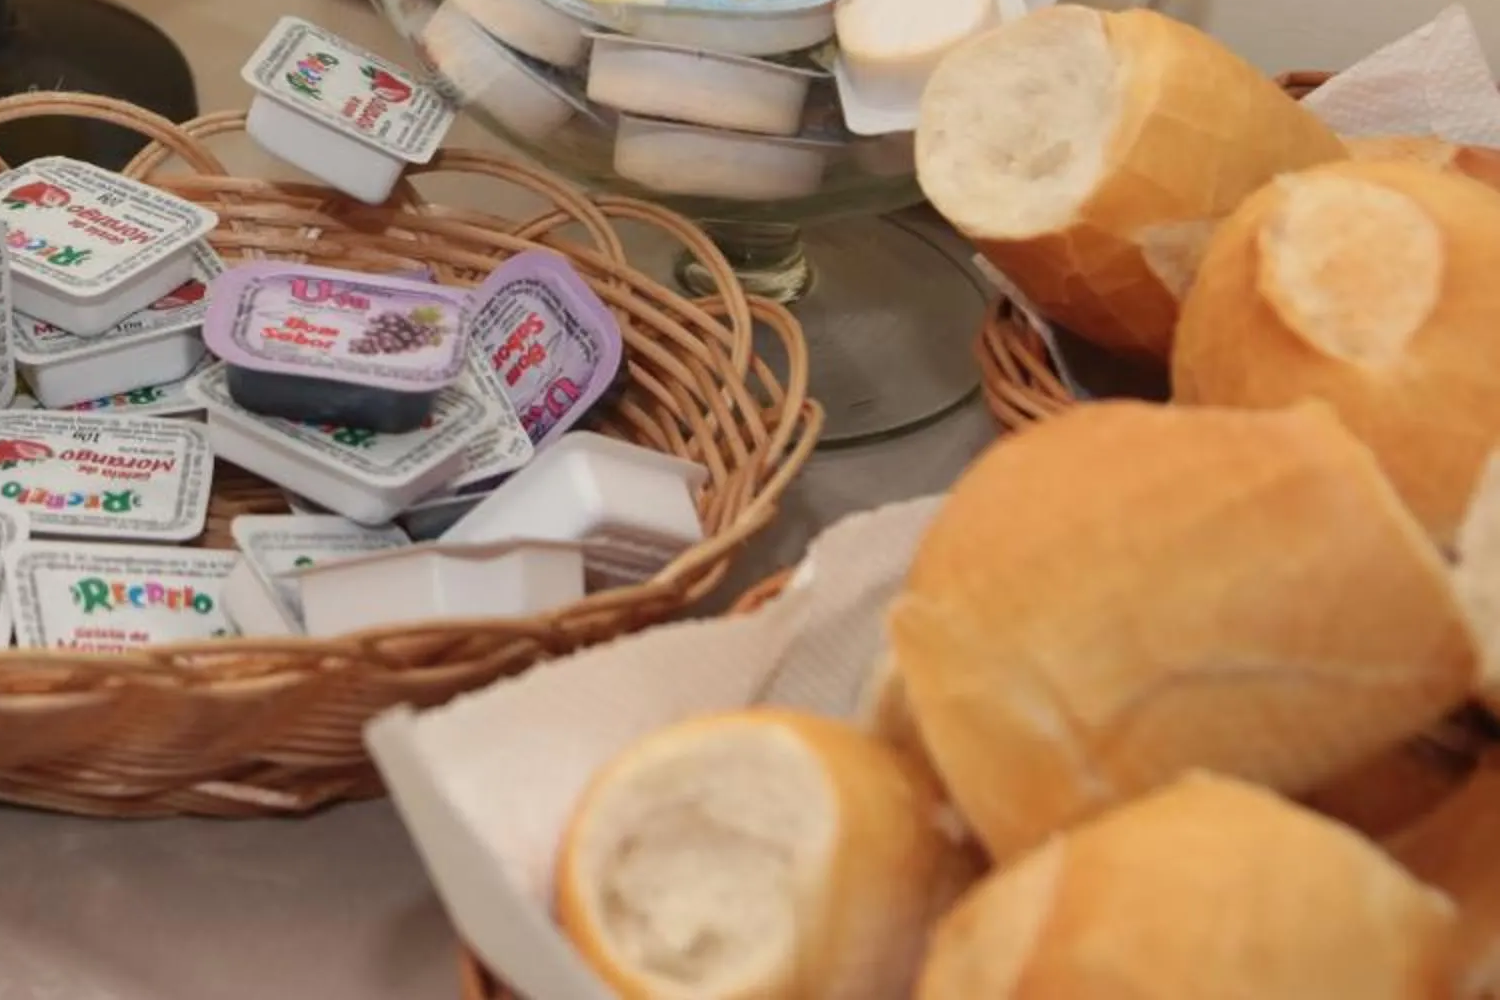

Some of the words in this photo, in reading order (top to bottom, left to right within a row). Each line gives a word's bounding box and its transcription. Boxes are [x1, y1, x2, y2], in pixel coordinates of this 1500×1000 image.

[260, 327, 336, 350] Sabor
[283, 316, 340, 336] Bom
[492, 312, 545, 370] Sabor
[505, 343, 546, 388] Bom
[59, 450, 175, 473] Morango
[1, 482, 142, 513] RECREIO
[70, 577, 213, 615] RECREIO
